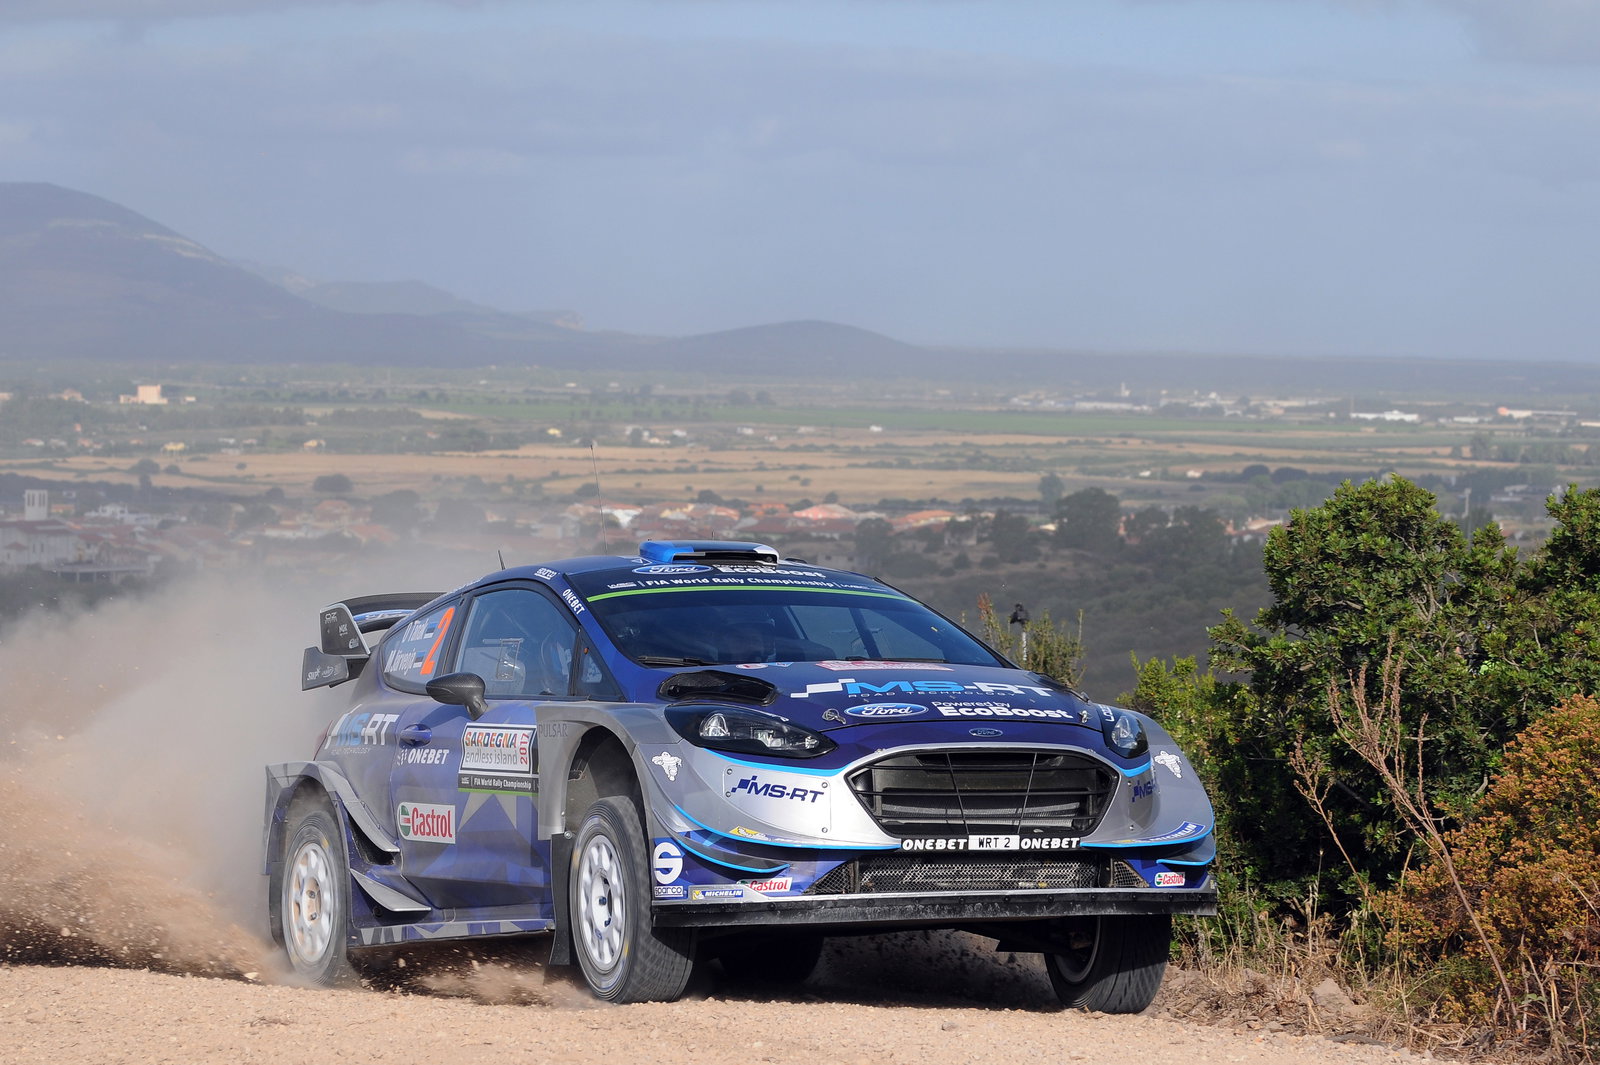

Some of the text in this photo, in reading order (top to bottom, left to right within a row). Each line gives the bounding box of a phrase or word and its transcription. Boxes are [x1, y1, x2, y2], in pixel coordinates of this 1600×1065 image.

[646, 564, 701, 574] Ford
[719, 565, 826, 579] EcoBoost
[747, 577, 834, 587] Championship
[562, 588, 585, 615] ONEBET
[420, 607, 455, 675] 2
[846, 680, 1053, 697] MS-RT
[859, 704, 915, 716] Ford
[936, 706, 1073, 719] EcoBoost
[538, 723, 568, 738] PULSAR
[465, 731, 518, 749] SARDEGNA
[519, 733, 530, 765] 2017
[407, 748, 449, 765] ONEBET
[465, 750, 518, 766] endless island
[481, 778, 493, 787] World
[493, 779, 503, 788] Rally
[503, 779, 532, 790] Championship
[746, 781, 825, 803] MS-RT
[411, 807, 453, 838] Castrol
[902, 837, 1080, 850] ONEBET WRT 2 ONEBET
[749, 879, 789, 891] Castrol
[1162, 873, 1185, 885] Castrol
[654, 886, 683, 896] sparco
[704, 889, 743, 898] MICHELIN
